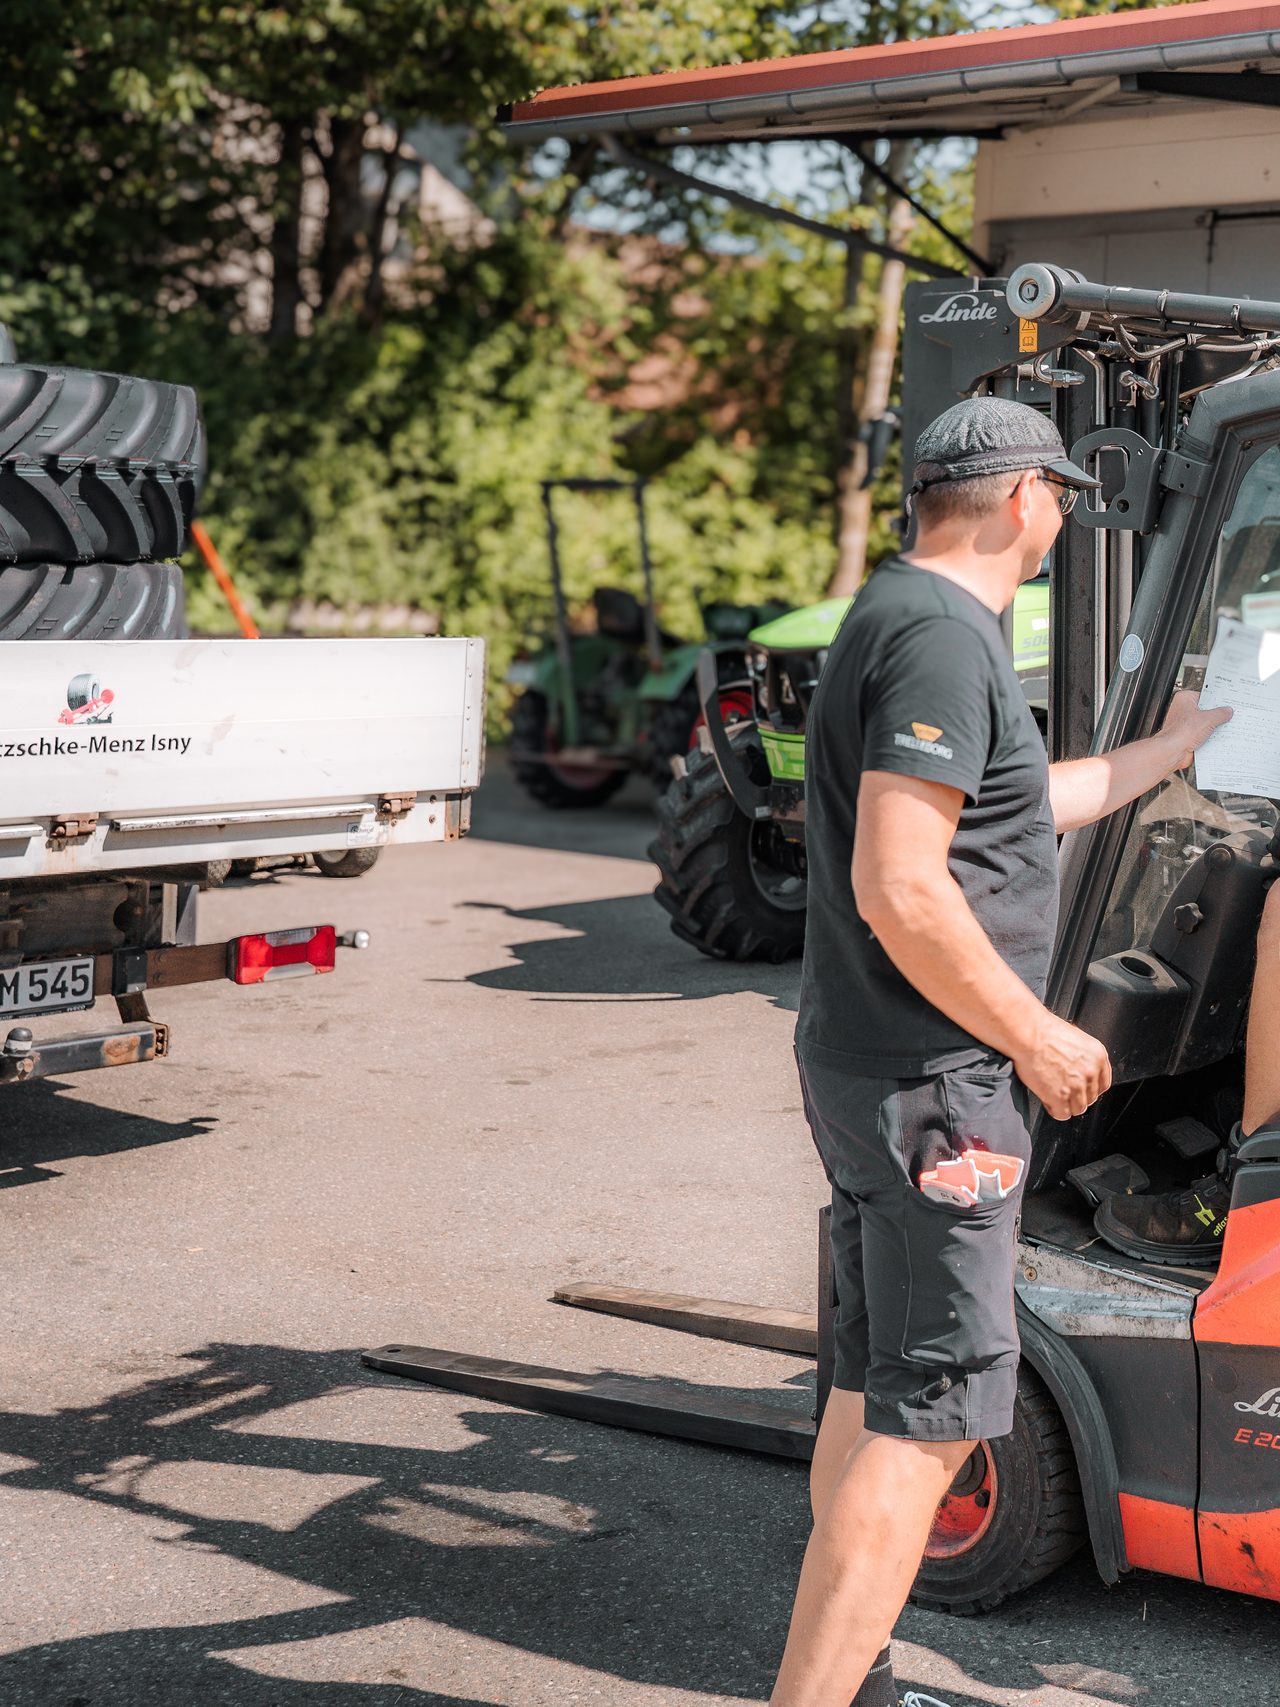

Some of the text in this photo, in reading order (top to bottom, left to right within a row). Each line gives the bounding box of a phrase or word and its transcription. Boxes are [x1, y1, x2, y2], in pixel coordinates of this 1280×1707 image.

[918, 294, 998, 323] Linde
[151, 734, 192, 755] Isny
[28, 963, 90, 1003] 545
[1233, 1427, 1254, 1443] E
